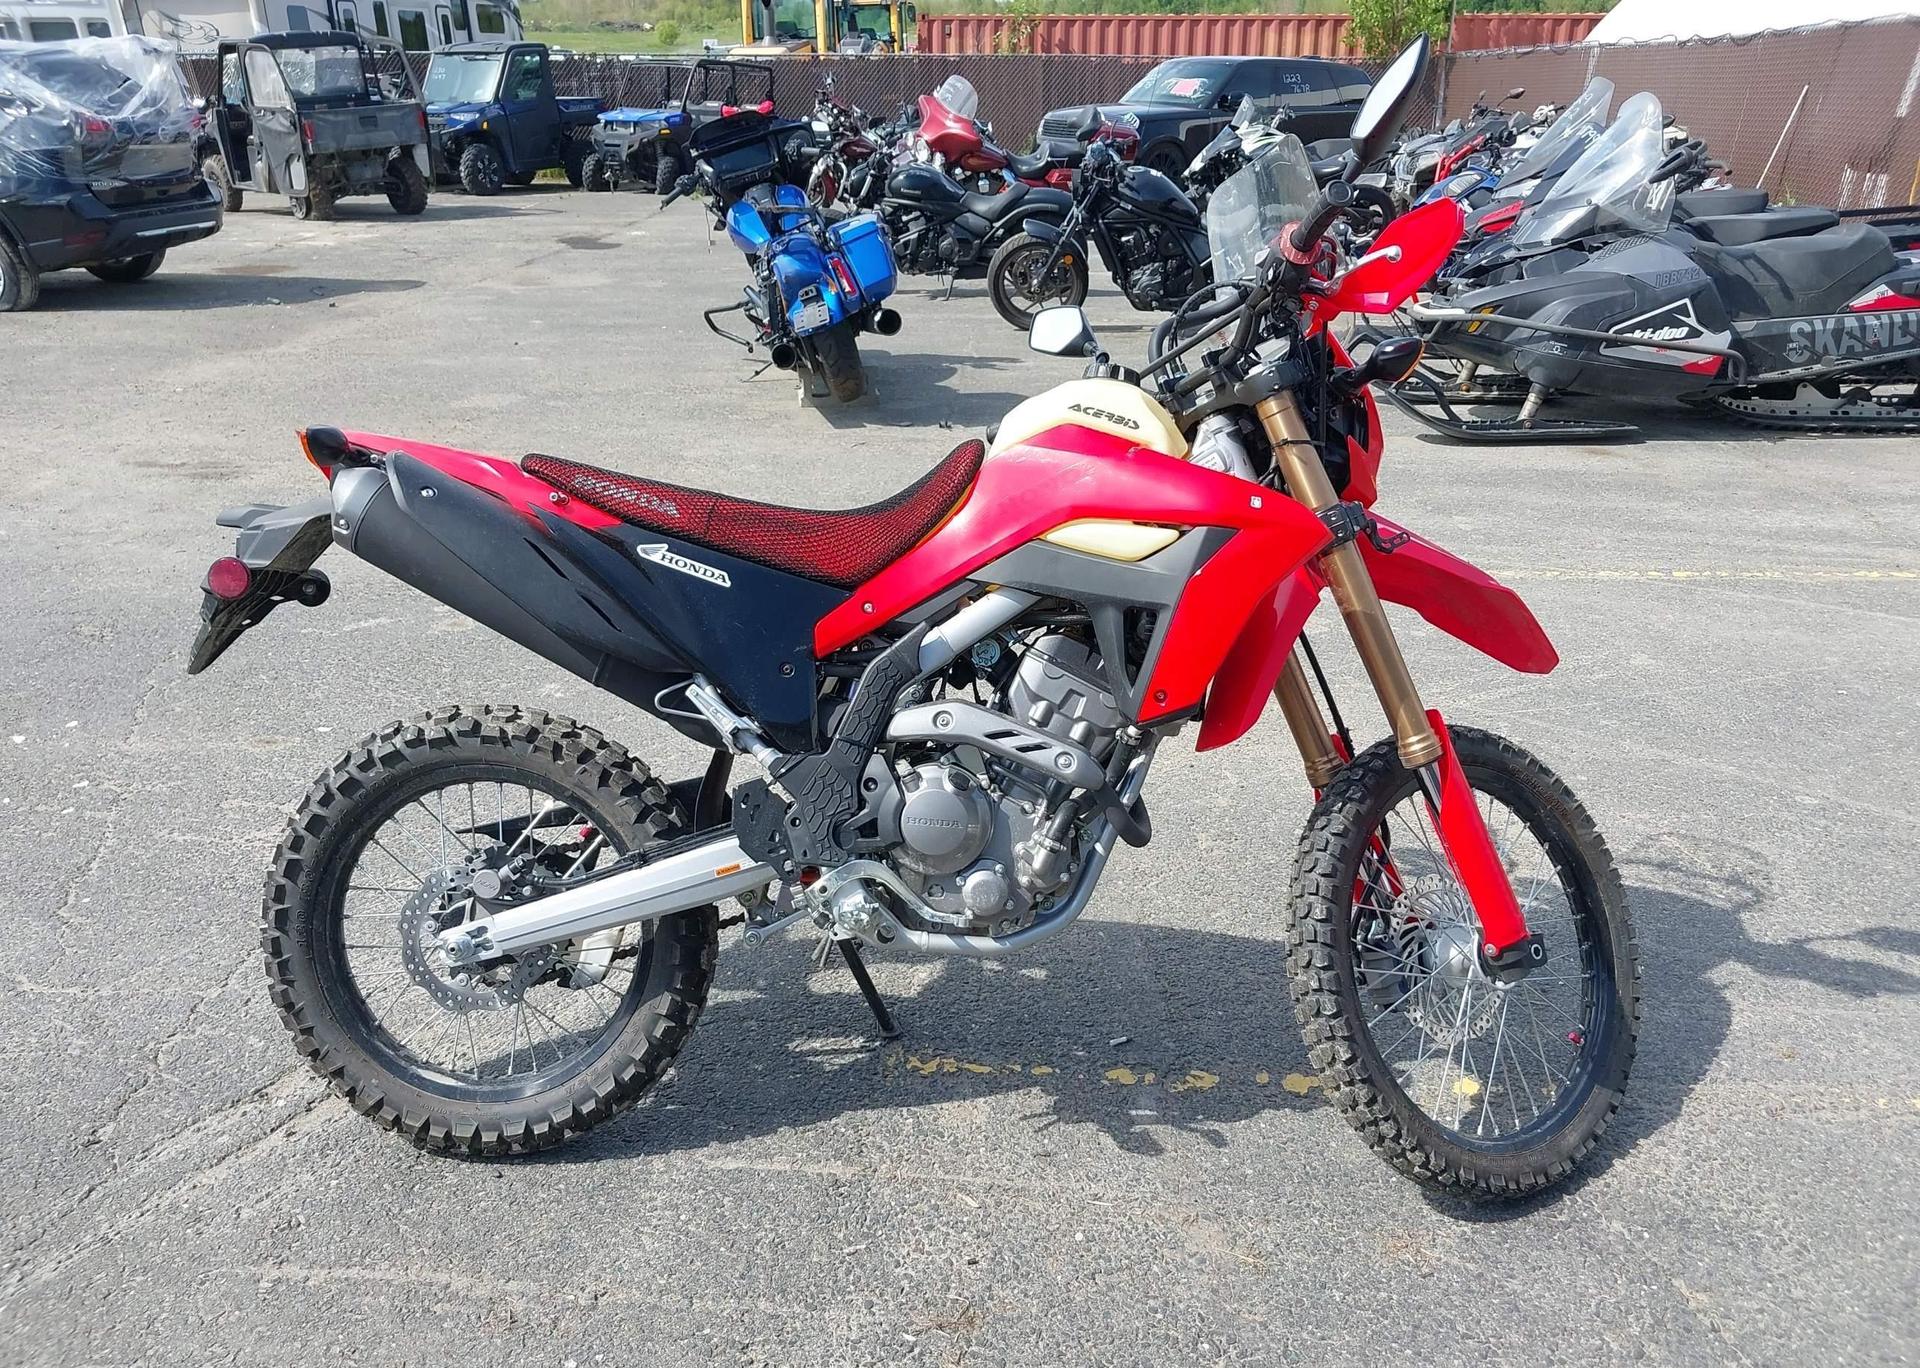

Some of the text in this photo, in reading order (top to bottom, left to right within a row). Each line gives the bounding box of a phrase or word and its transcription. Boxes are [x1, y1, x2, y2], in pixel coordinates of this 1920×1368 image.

[1067, 403, 1140, 430] ACERBIS
[660, 551, 729, 583] HONDA
[906, 816, 964, 829] HONDA
